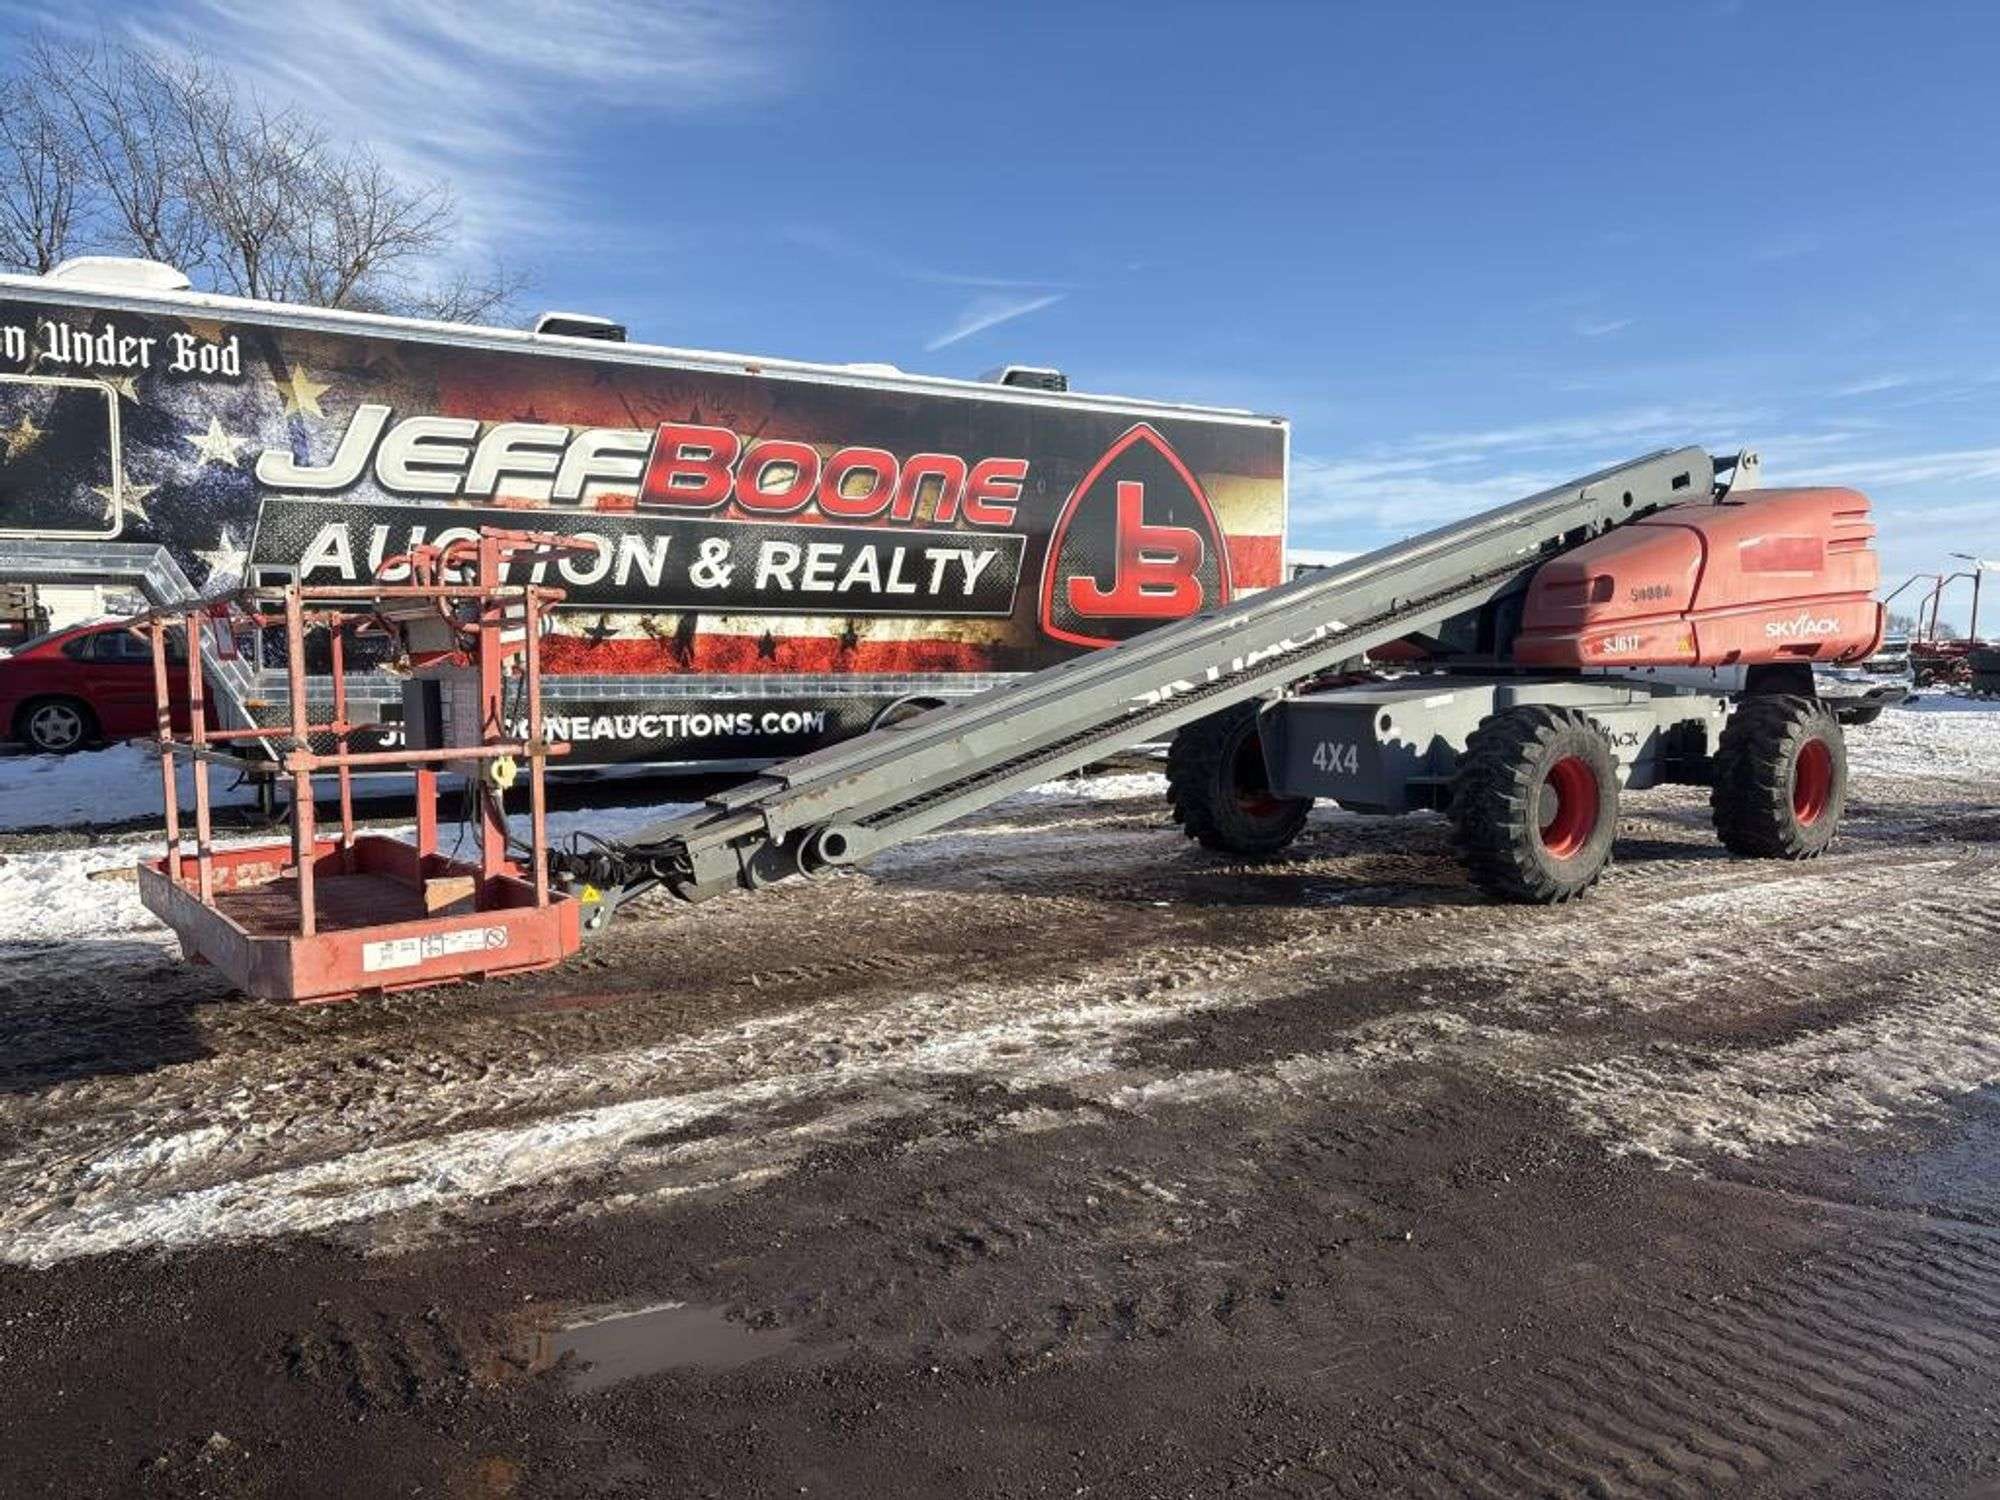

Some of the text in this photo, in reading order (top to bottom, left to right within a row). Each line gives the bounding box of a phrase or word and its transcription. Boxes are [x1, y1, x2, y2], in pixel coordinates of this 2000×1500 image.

[38, 320, 157, 368] Under
[637, 421, 1029, 527] BOONE
[688, 538, 733, 588] &
[754, 539, 996, 597] REALTY
[1066, 480, 1204, 617] JB
[1764, 611, 1840, 637] SKYJACK
[1312, 742, 1360, 775] 4X4
